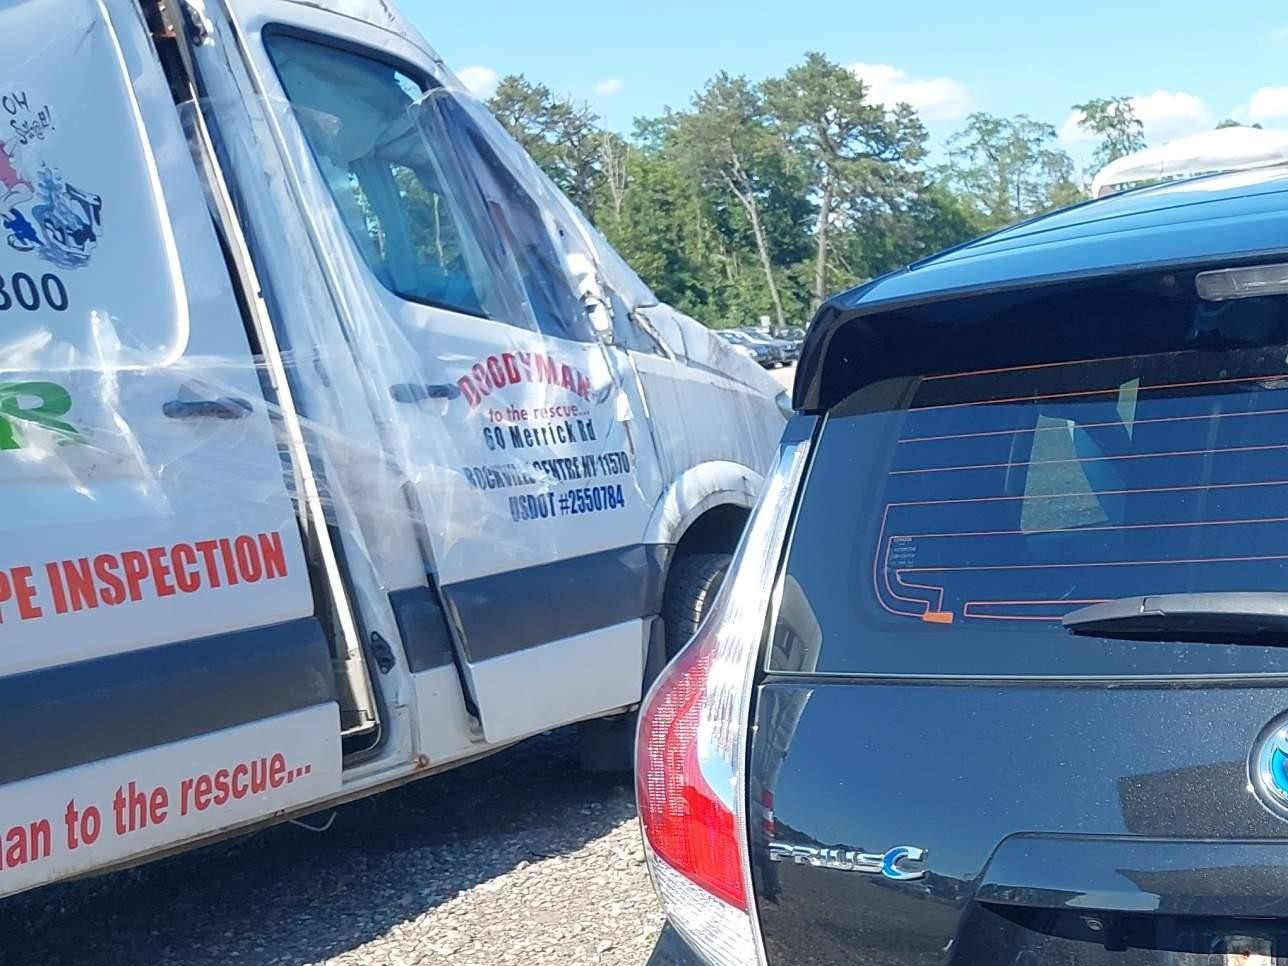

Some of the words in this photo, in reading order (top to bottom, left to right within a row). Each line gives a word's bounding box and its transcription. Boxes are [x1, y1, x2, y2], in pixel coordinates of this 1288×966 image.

[3, 92, 31, 115] OH
[489, 408, 503, 423] to
[507, 404, 528, 422] the
[509, 421, 577, 449] Merrick
[577, 419, 597, 442] Rd
[581, 454, 598, 478] NY
[598, 451, 631, 476] 11570
[508, 492, 556, 522] USDOT
[559, 484, 625, 516] #2550784
[46, 532, 288, 614] INSPECTION
[0, 818, 51, 870] an
[65, 799, 101, 850] to
[113, 781, 169, 835] the
[180, 752, 312, 816] rescue...
